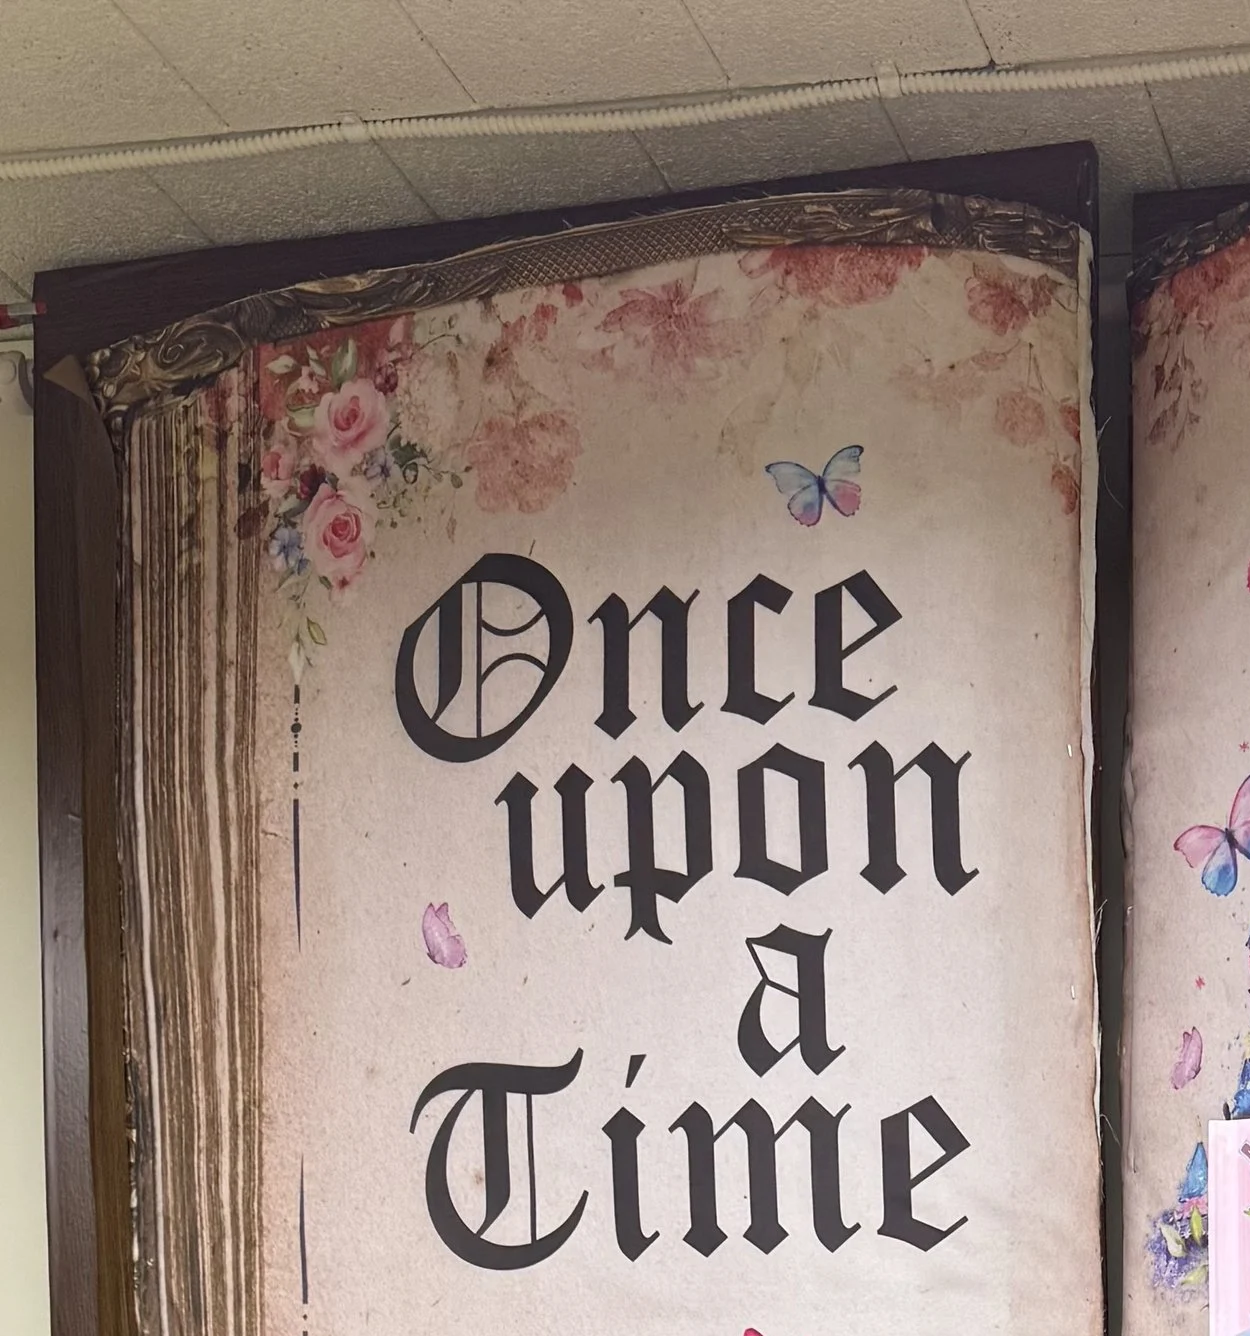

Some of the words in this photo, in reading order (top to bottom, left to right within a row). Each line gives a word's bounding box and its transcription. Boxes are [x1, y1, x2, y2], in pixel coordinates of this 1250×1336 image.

[395, 553, 903, 763] Once
[494, 741, 980, 945] upon
[737, 923, 846, 1077] a
[409, 1048, 971, 1270] Time
